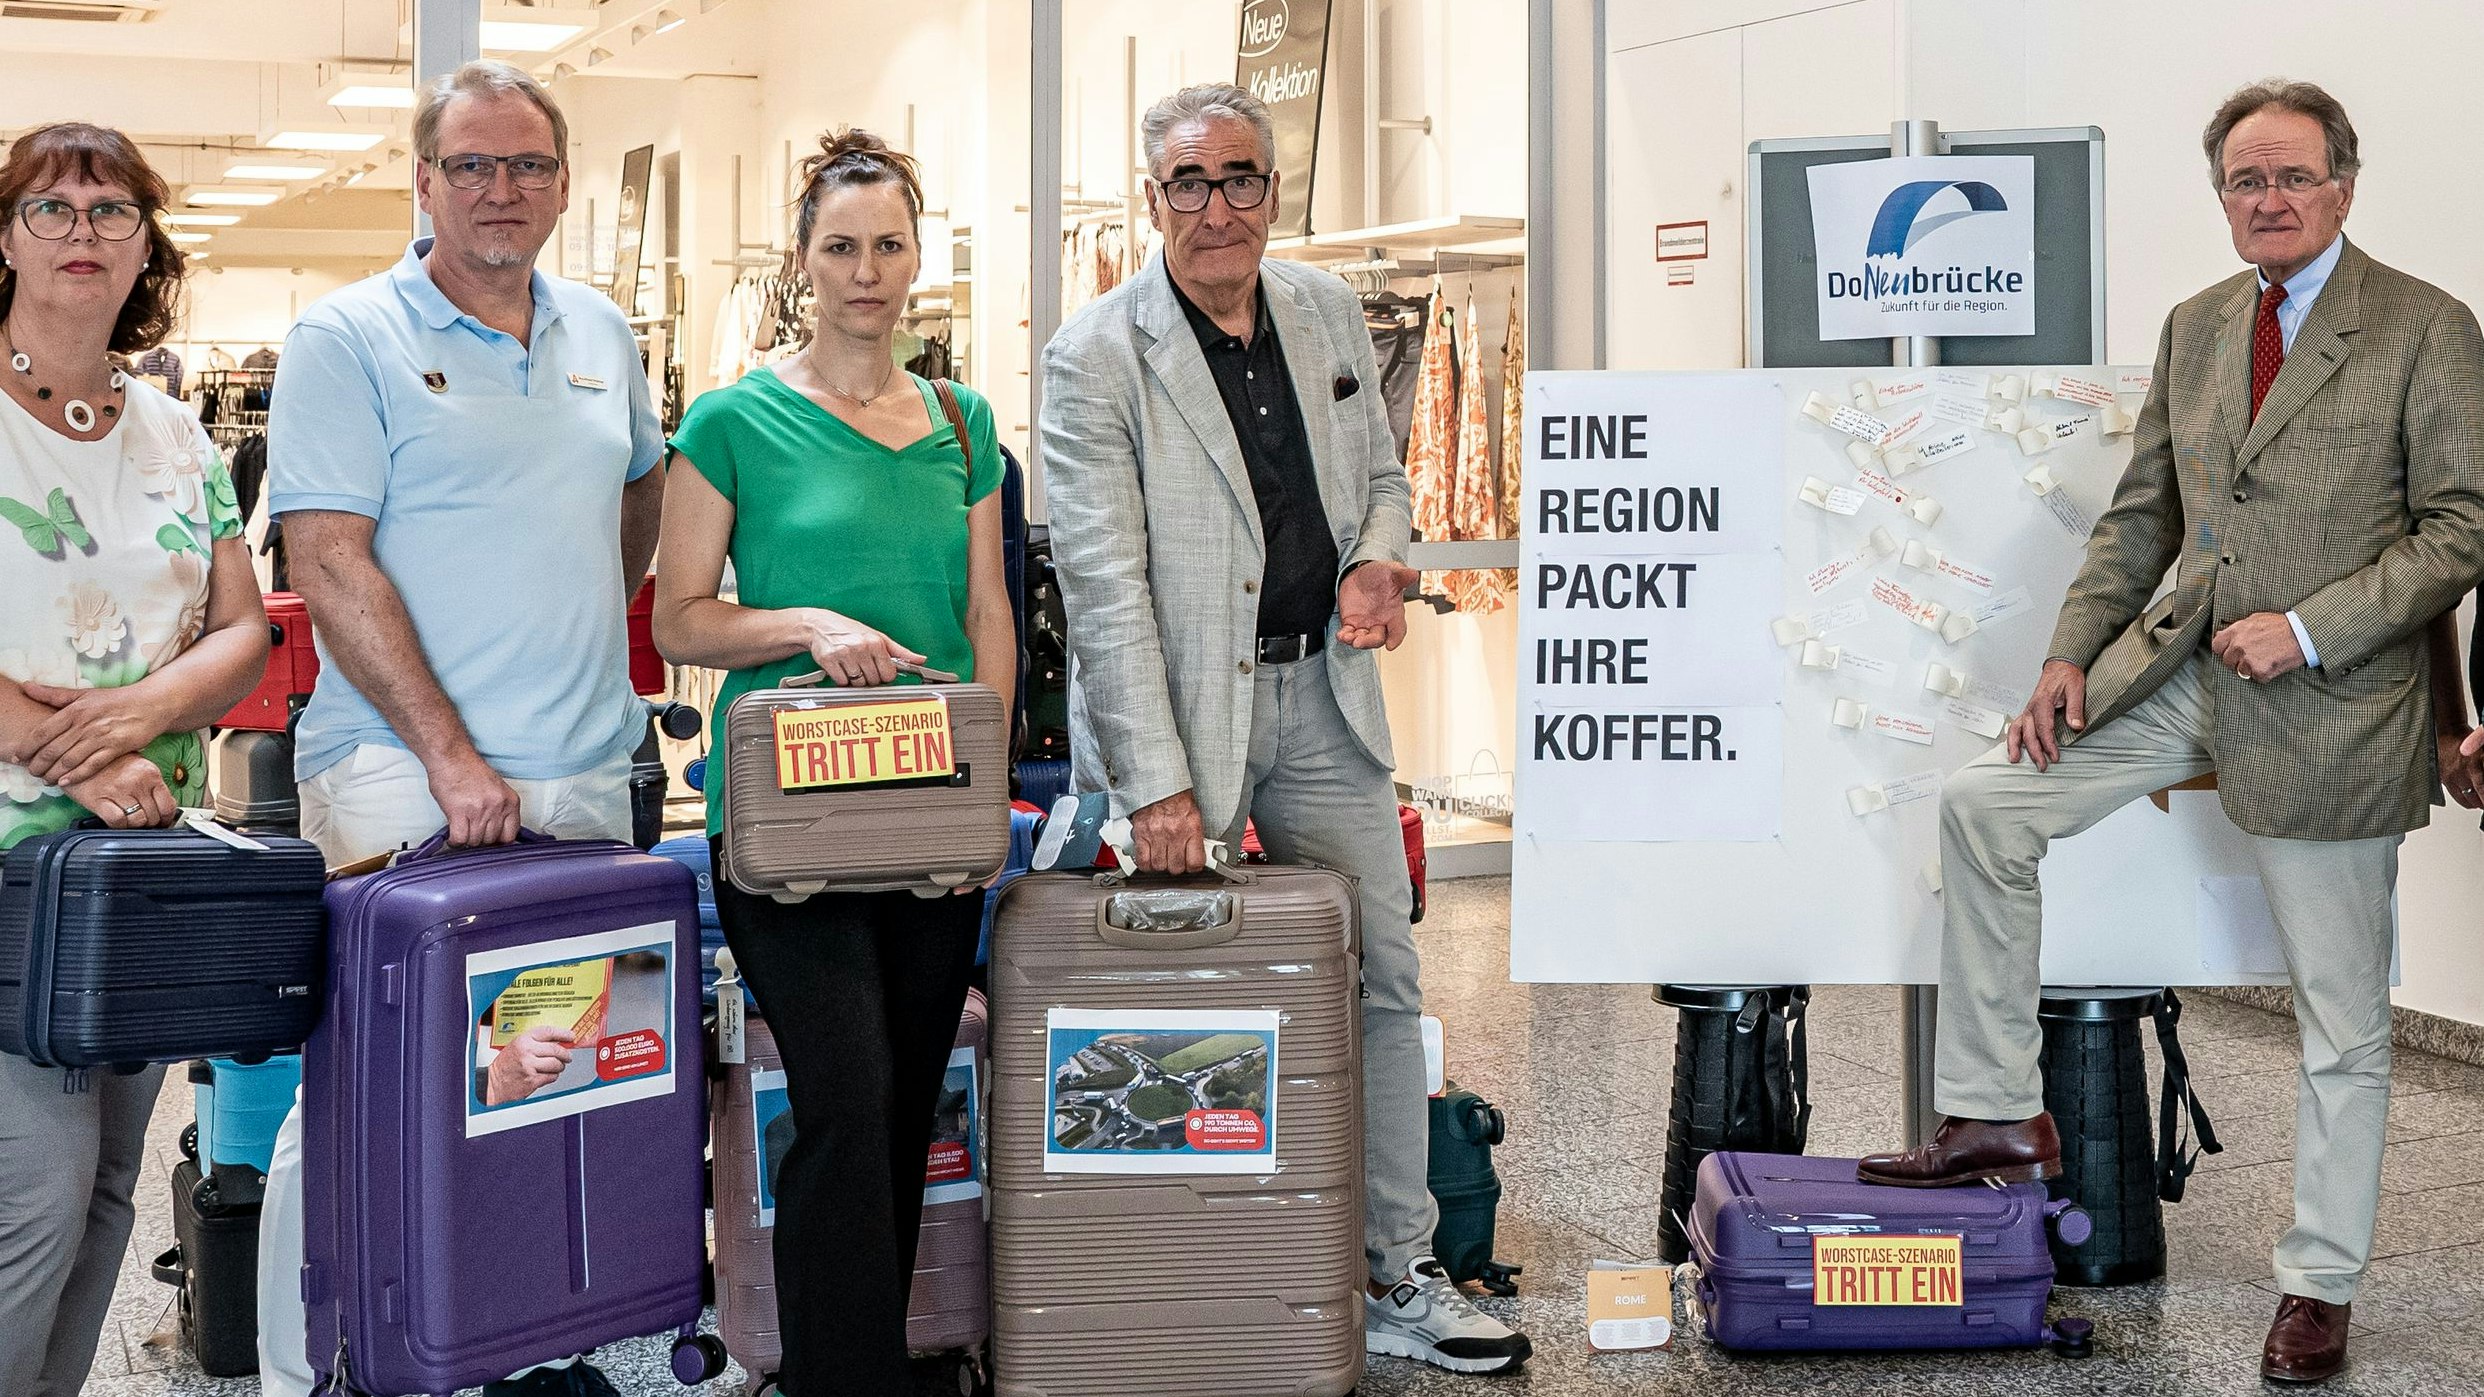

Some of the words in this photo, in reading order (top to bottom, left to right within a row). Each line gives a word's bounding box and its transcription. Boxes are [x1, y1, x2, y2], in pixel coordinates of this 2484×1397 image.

[1242, 9, 1283, 48] Neue
[1249, 62, 1318, 105] Kollektion
[1881, 301, 1919, 313] Zukunft
[1922, 300, 1940, 312] für
[1943, 300, 1961, 311] die
[1964, 300, 2008, 314] Region.
[1540, 414, 1648, 460] EINE
[1539, 486, 1720, 534] REGION
[1537, 562, 1697, 609] PACKT
[1536, 638, 1649, 685] IHRE
[782, 711, 943, 741] WORSTCASE-SZENARIO
[1533, 713, 1737, 761] KOFFER.
[784, 737, 881, 784] TRITT
[892, 731, 948, 775] EIN
[522, 977, 542, 988] FOLGEN
[543, 976, 556, 987] FÜR
[1821, 1247, 1956, 1264] WORSTCASE-SZENARIO
[1615, 1294, 1647, 1306] ROME
[1821, 1266, 1902, 1302] TRITT
[1912, 1266, 1957, 1302] EIN
